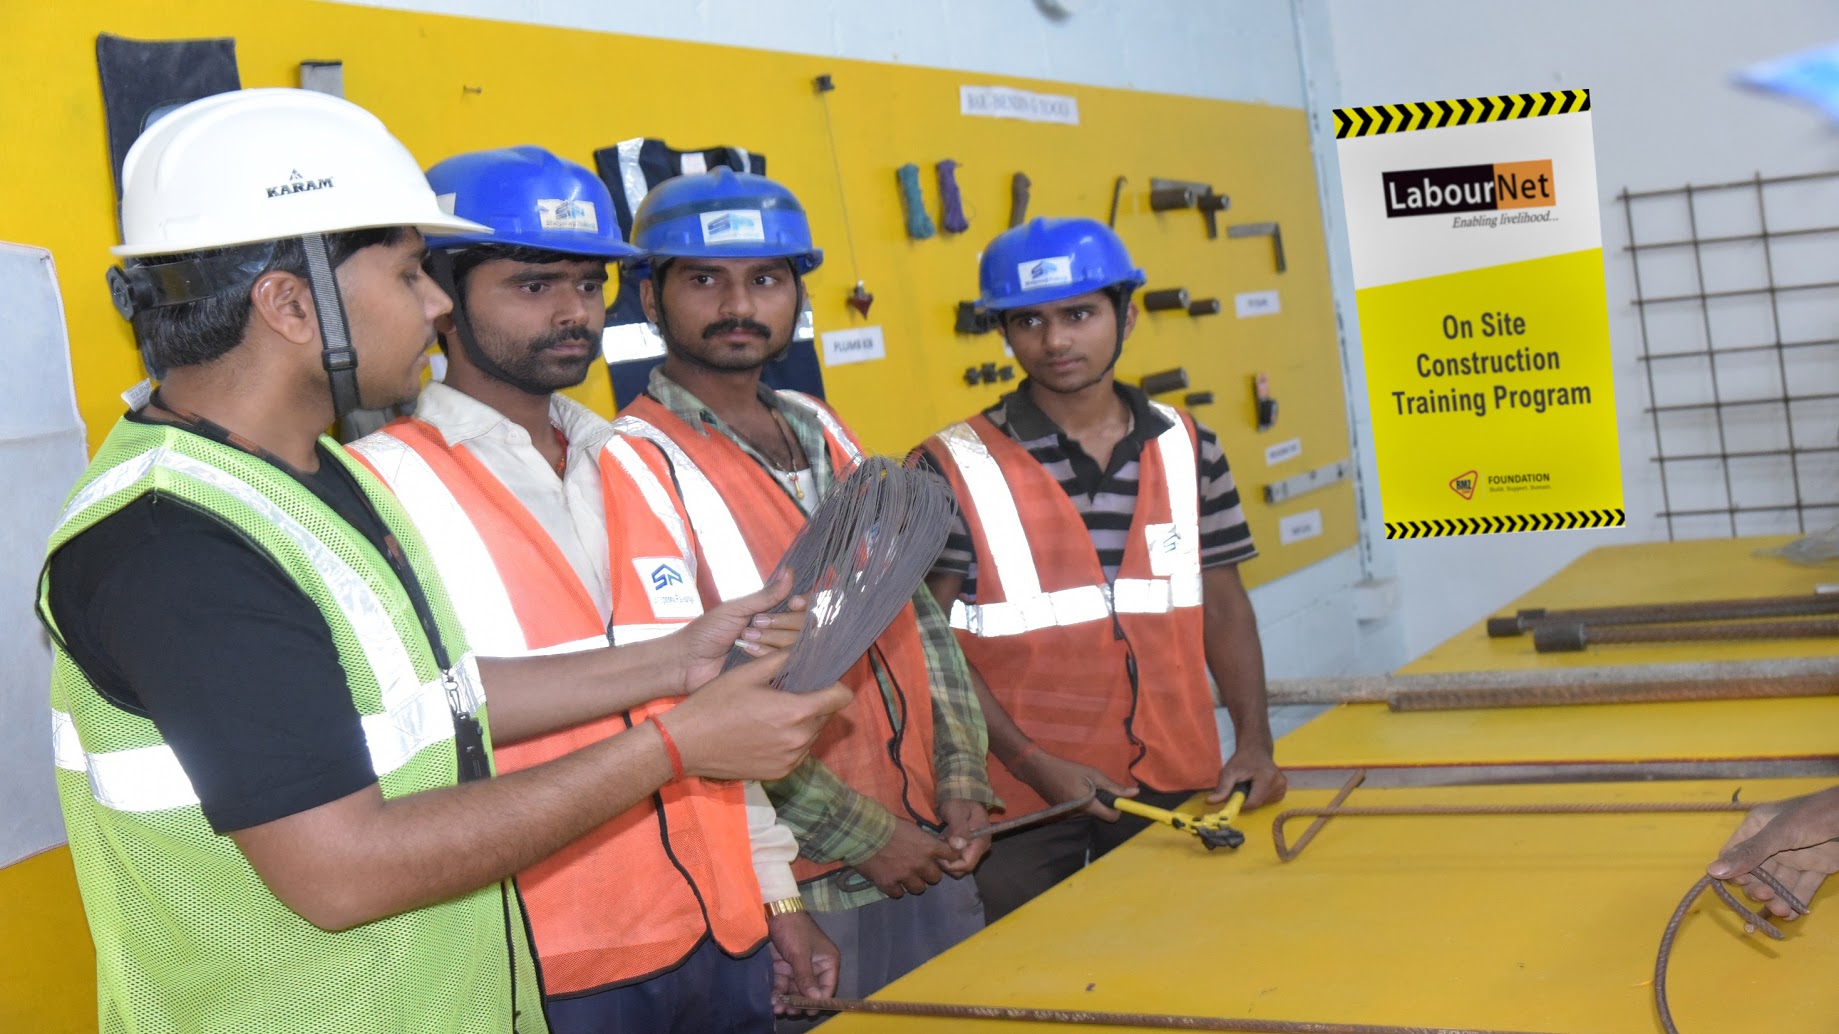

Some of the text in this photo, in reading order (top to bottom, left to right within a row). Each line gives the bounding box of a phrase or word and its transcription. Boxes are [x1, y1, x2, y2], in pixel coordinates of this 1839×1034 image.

[266, 178, 334, 198] KARAM
[1389, 173, 1550, 210] LabourNet
[1452, 210, 1559, 229] Enabling livelihood...
[1443, 311, 1526, 340] On Site
[1416, 347, 1560, 378] Construction
[1391, 384, 1592, 417] Training Program
[1488, 473, 1550, 485] FOUNDATION
